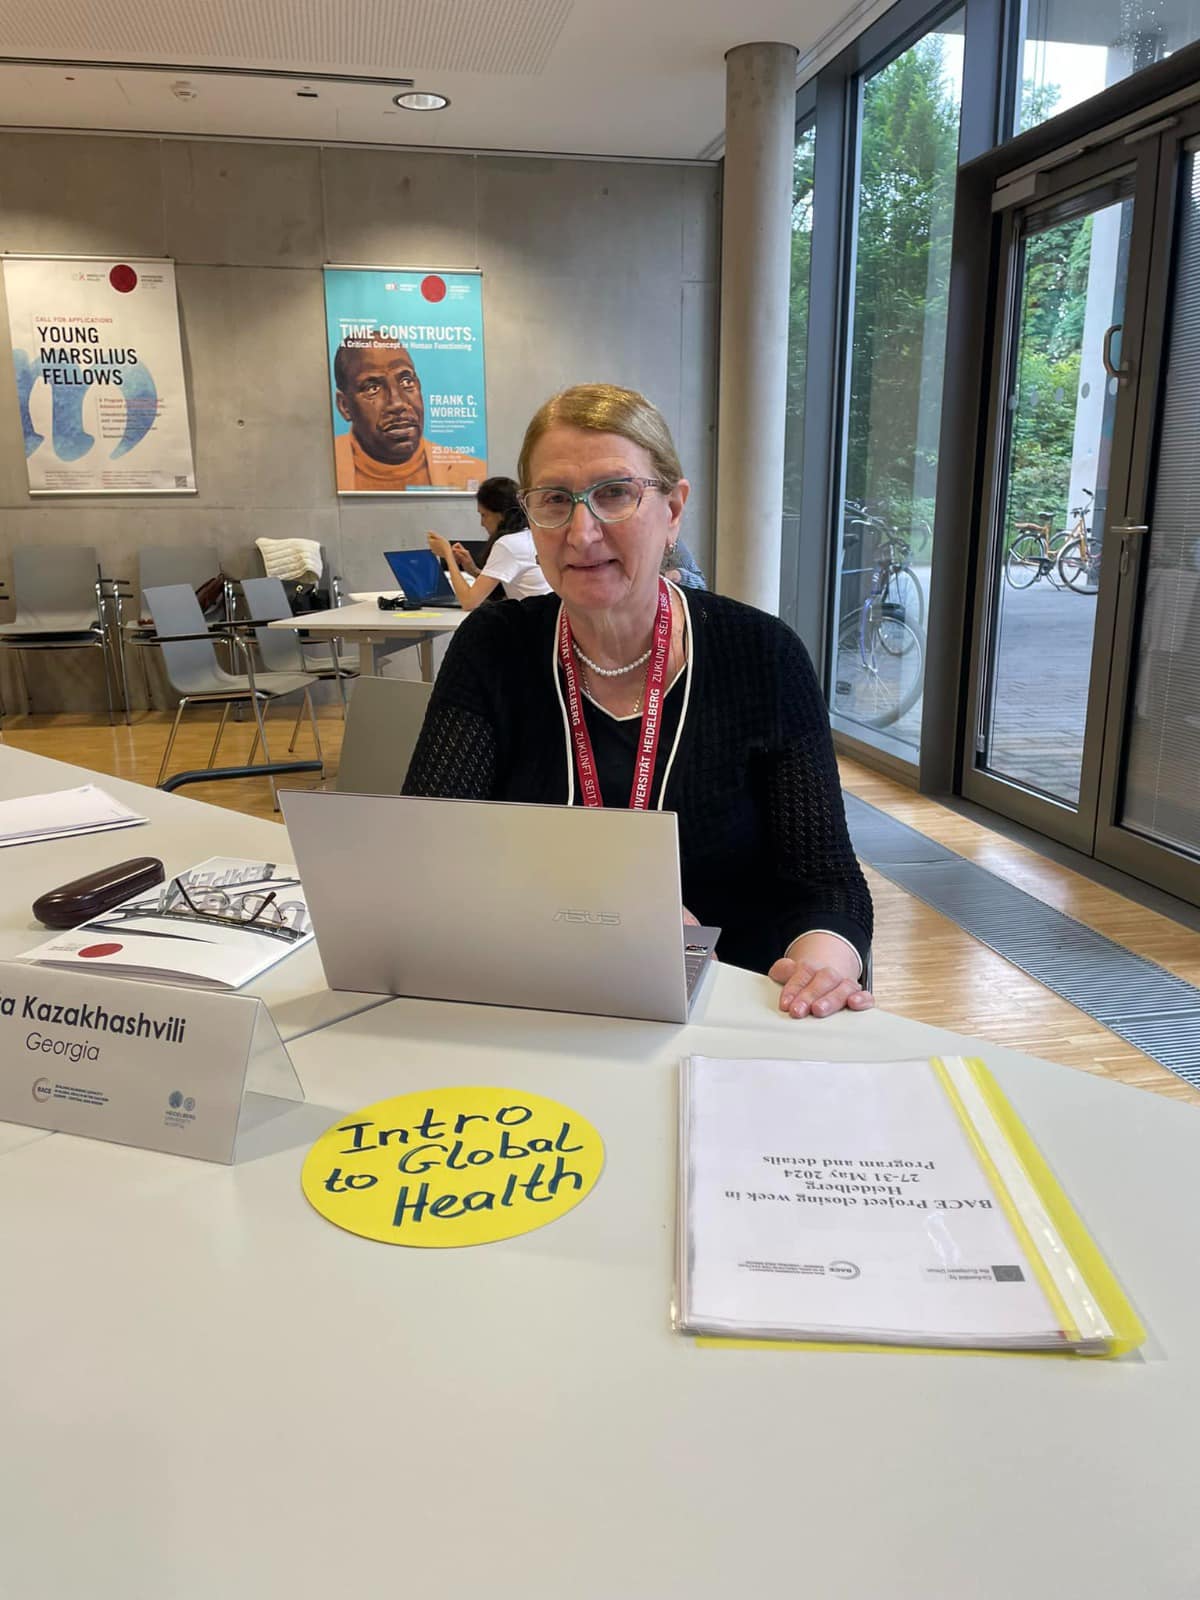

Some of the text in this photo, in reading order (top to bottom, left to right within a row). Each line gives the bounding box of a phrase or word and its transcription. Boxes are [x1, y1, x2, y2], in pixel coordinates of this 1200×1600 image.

[37, 326, 99, 343] YOUNG
[339, 324, 476, 341] TIME CONSTRUCTS.
[347, 340, 372, 348] Critical
[373, 341, 401, 350] Concept
[410, 341, 433, 349] Human
[40, 347, 138, 365] MARSILIUS
[42, 368, 123, 385] FELLOWS
[429, 394, 477, 406] FRANK C.
[430, 407, 477, 418] WORRELL
[658, 612, 669, 635] SEIT
[652, 637, 667, 683] ZUKUNFT
[643, 688, 660, 753] HEIDELBERG
[565, 663, 581, 727] HEIDELBERG
[575, 731, 592, 776] ZUKUNFT
[584, 778, 597, 801] SEIT
[552, 909, 621, 926] ASUS
[22, 995, 187, 1043] Kazakhashvili
[25, 1032, 100, 1062] Georgia
[397, 1122, 584, 1174] Global
[762, 1154, 935, 1171] Program and details
[324, 1167, 379, 1193] to
[783, 1169, 920, 1184] 27-31 May 2024
[392, 1156, 584, 1227] Health
[805, 1181, 902, 1196] Heidelberg
[725, 1190, 993, 1210] BACE Project closing week in
